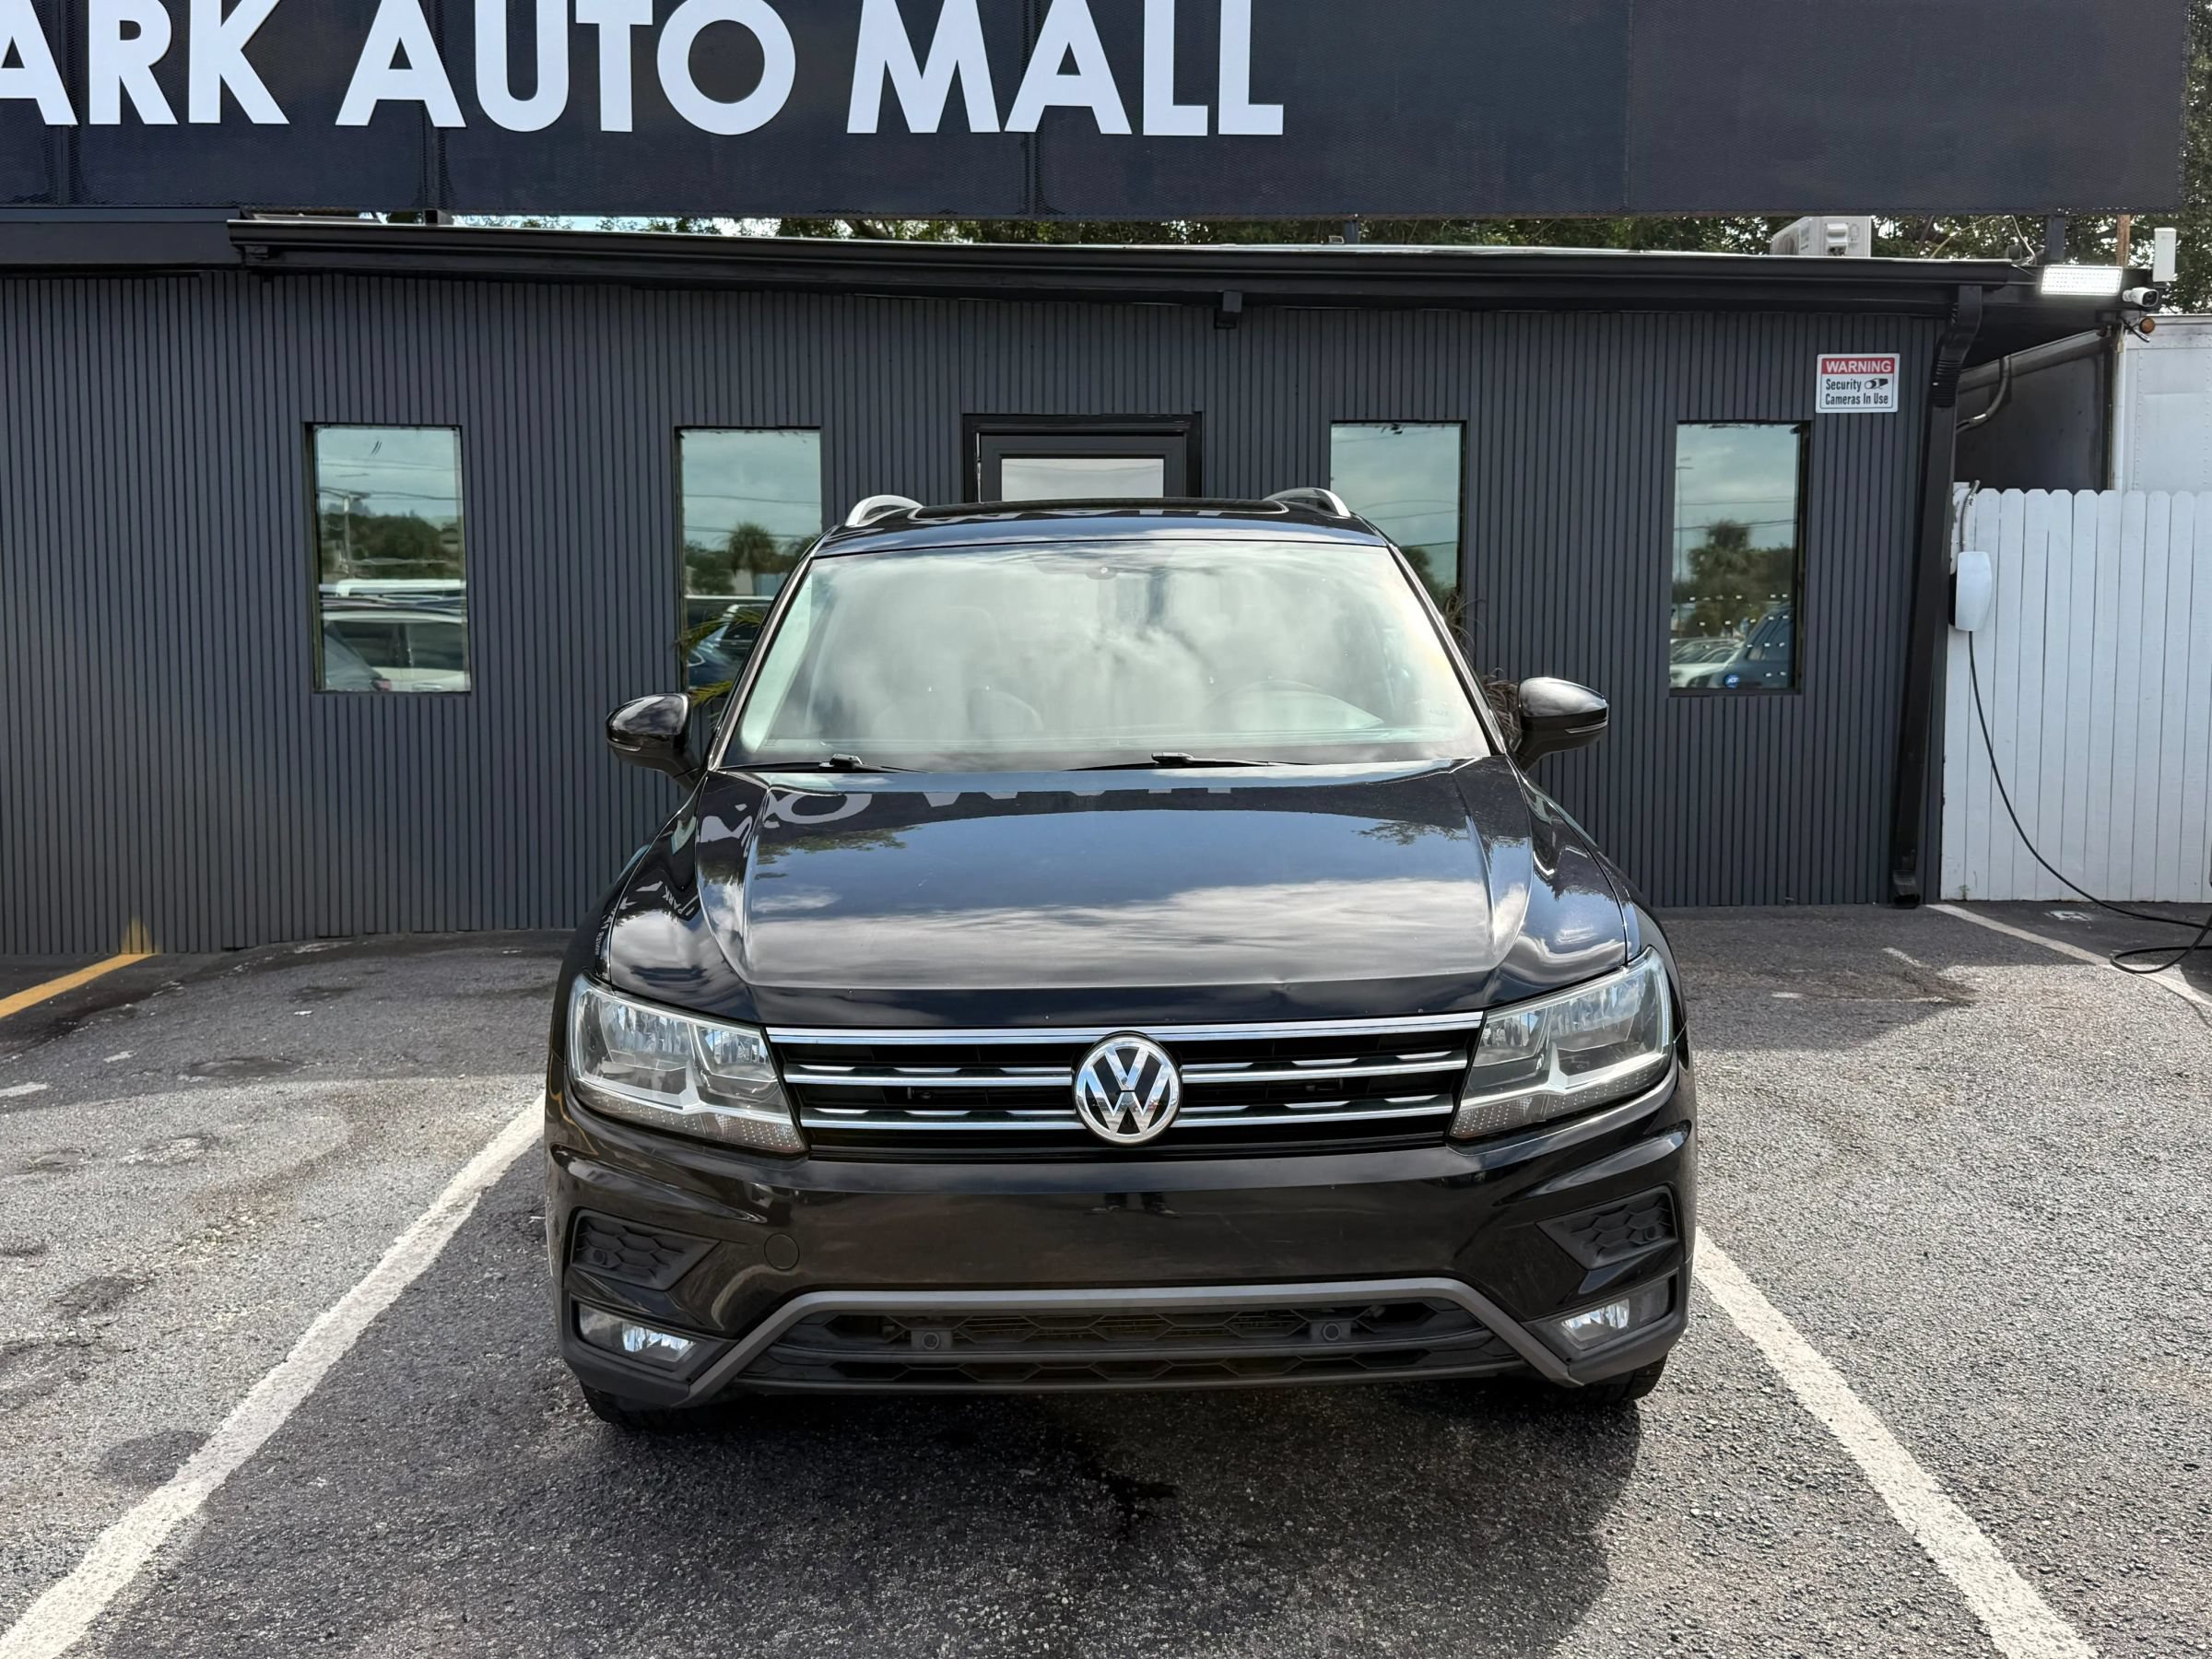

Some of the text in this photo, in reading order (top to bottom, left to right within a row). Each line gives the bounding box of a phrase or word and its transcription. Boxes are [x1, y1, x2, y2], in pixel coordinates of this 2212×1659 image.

[335, 0, 795, 135] AUTO
[846, 0, 1284, 135] MALL
[1826, 360, 1891, 372] WARNING
[1826, 378, 1862, 392] Security
[1825, 393, 1888, 405] Cameras In Use
[1076, 1035, 1179, 1143] VW
